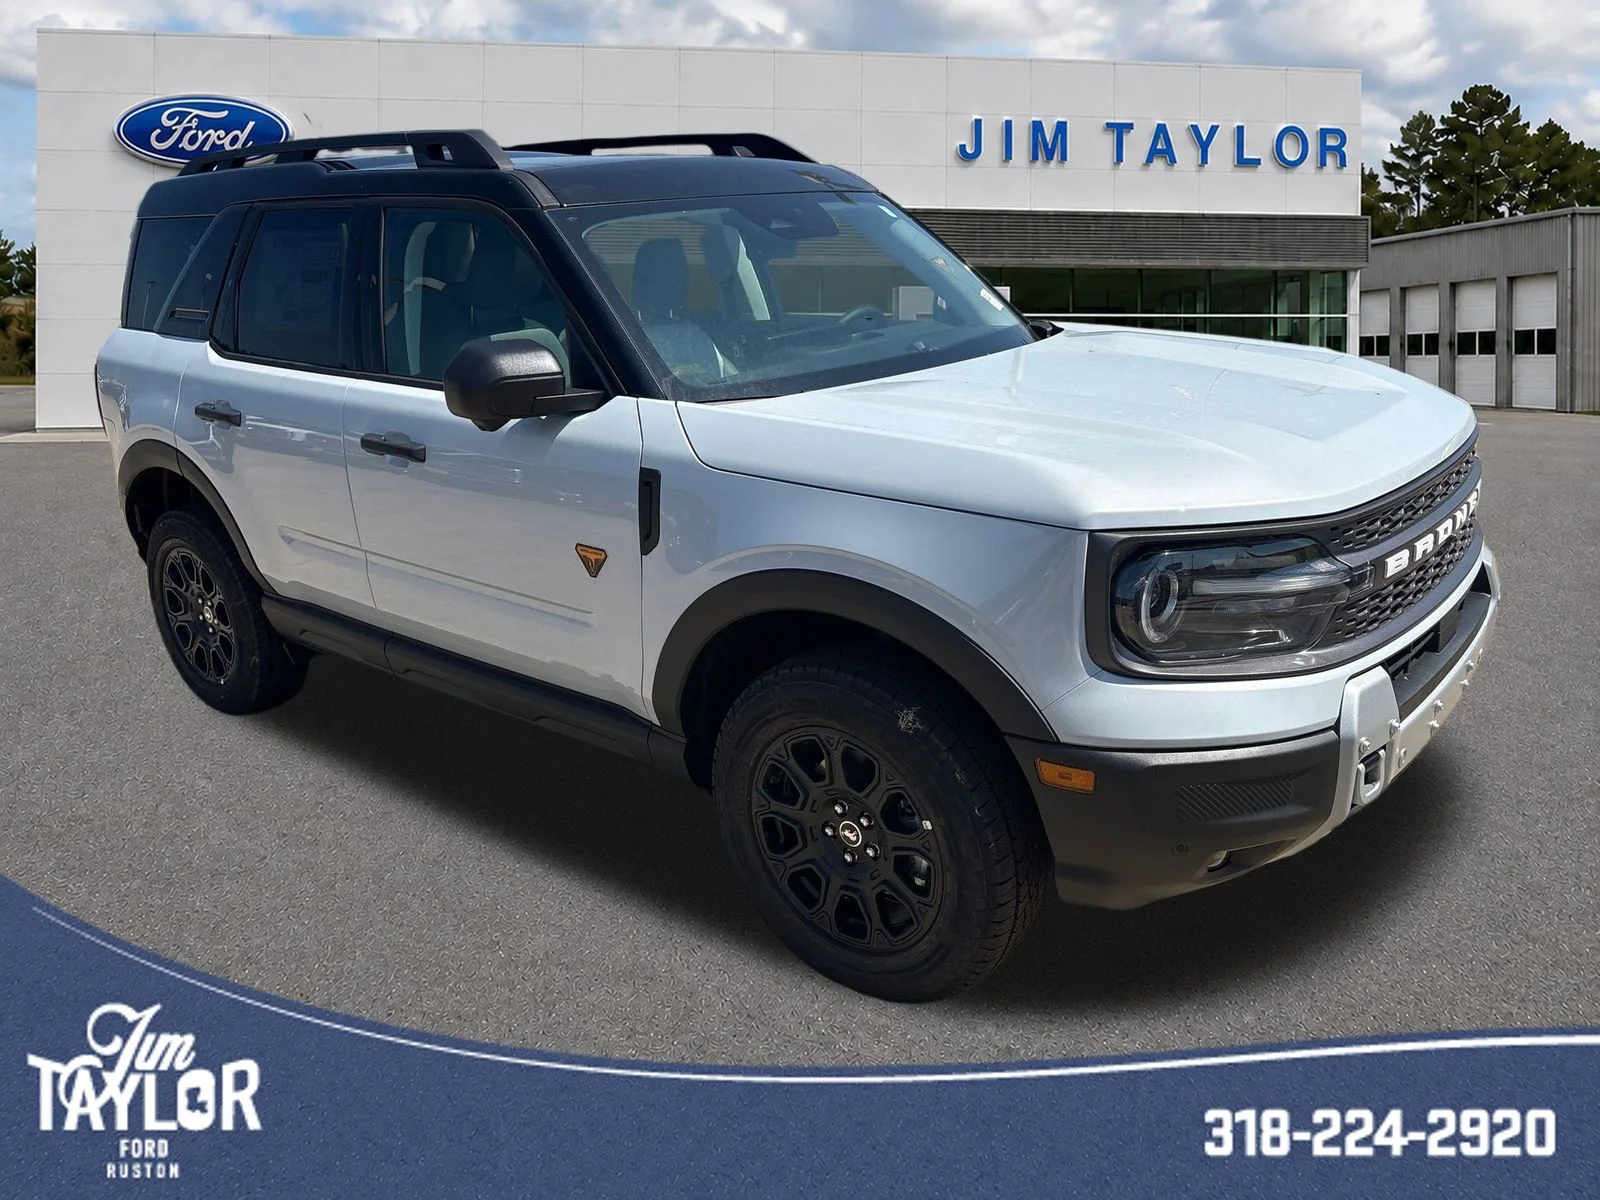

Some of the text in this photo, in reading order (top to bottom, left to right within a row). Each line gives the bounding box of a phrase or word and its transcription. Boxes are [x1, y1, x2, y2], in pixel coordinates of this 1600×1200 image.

[150, 107, 256, 151] Ford
[957, 115, 1349, 170] JIM TAYLOR
[1384, 478, 1482, 579] BRONC
